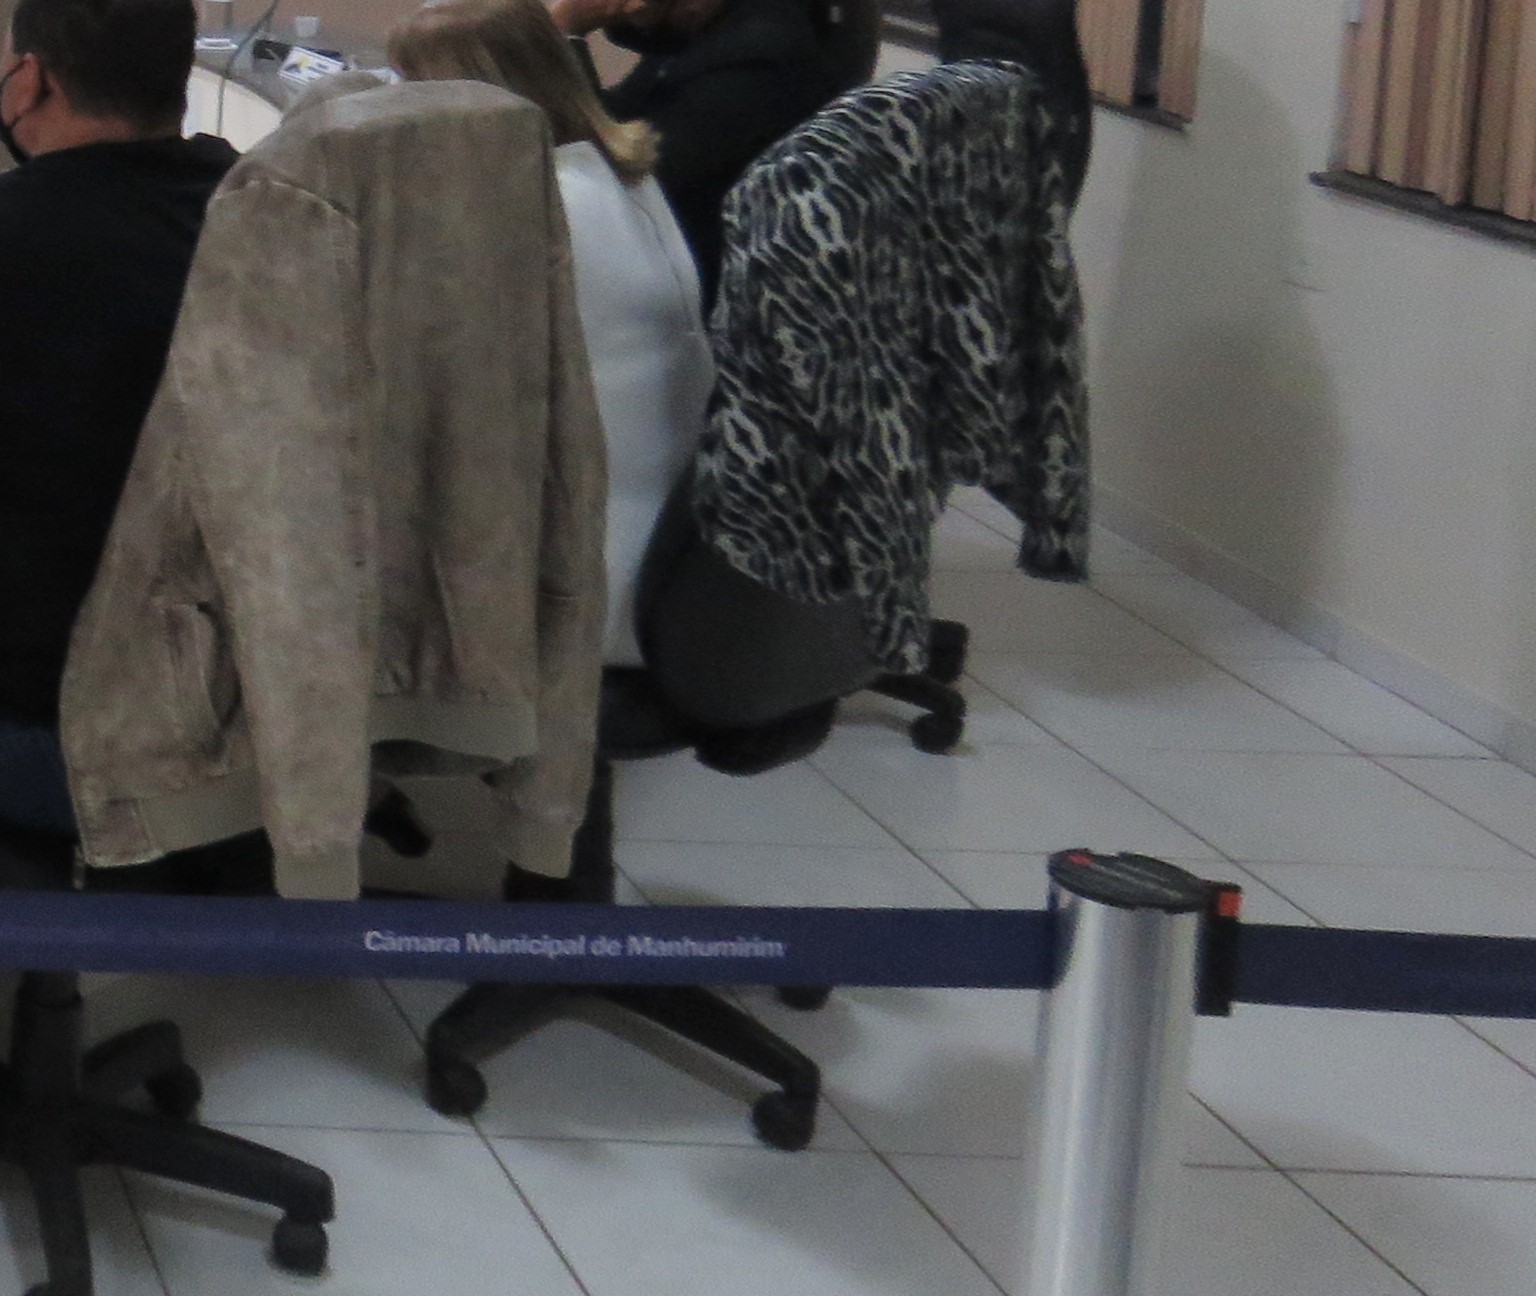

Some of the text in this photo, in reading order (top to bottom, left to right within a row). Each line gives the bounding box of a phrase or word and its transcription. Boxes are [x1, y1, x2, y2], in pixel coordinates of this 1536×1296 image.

[364, 930, 786, 958] Câmara Municipal de Manhumirim
